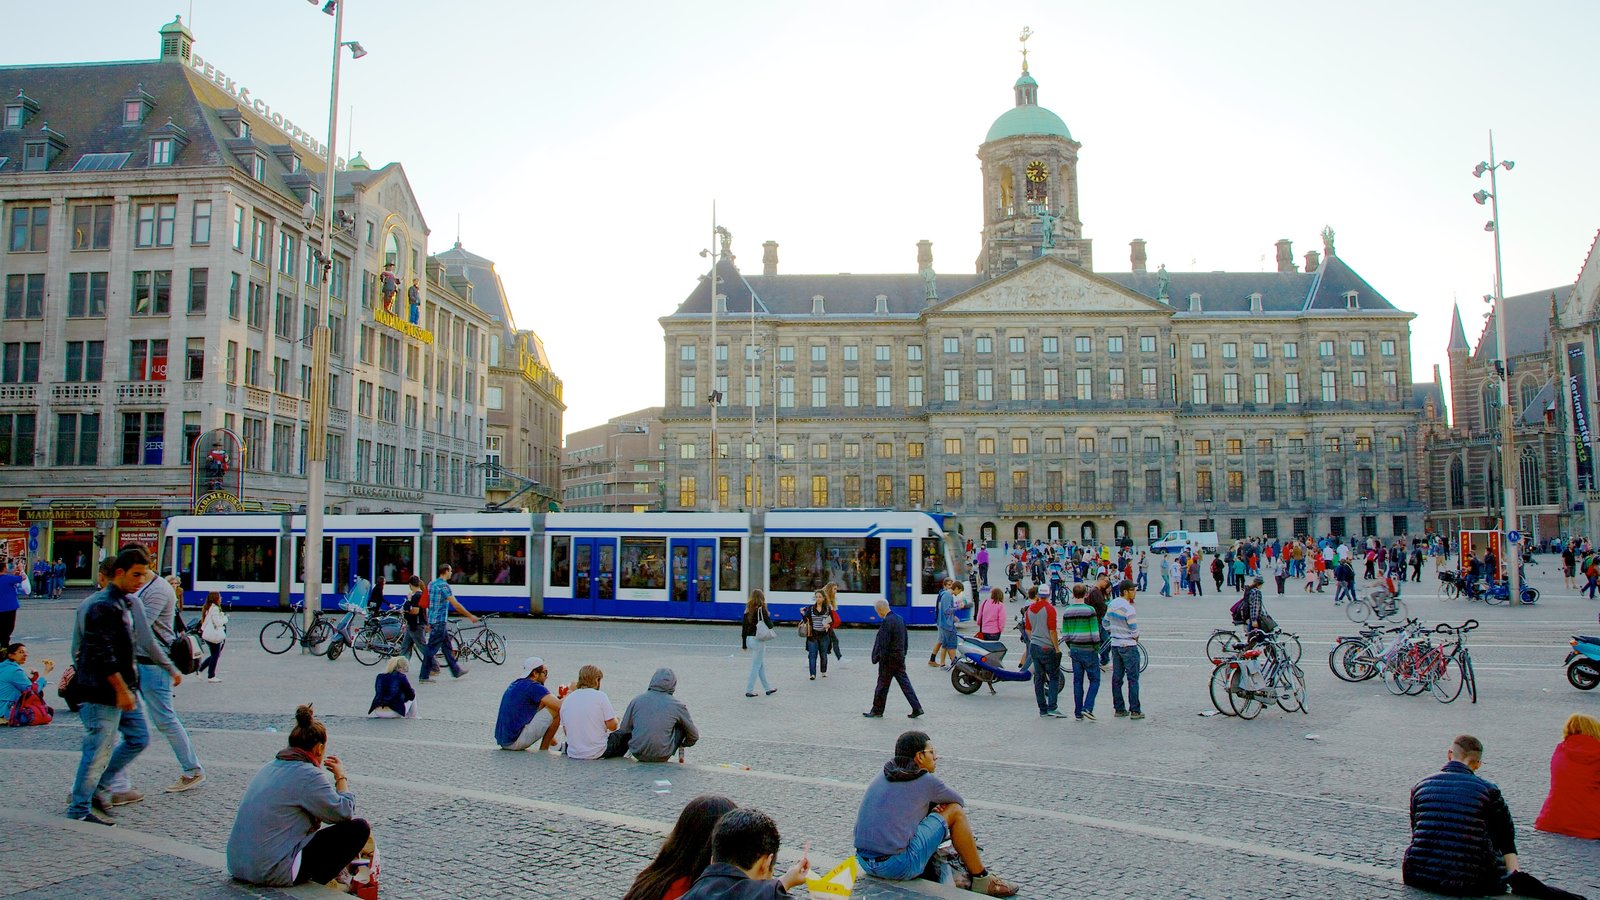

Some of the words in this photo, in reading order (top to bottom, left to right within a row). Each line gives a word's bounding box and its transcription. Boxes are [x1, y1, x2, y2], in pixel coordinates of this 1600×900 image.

[191, 53, 236, 96] PEEK
[238, 87, 252, 106] &
[254, 99, 346, 171] CLOPPENBR
[1570, 375, 1591, 448] Kerkmeester
[1575, 434, 1588, 463] 2012
[26, 510, 71, 519] MADAME
[77, 510, 120, 519] TUSSAUD
